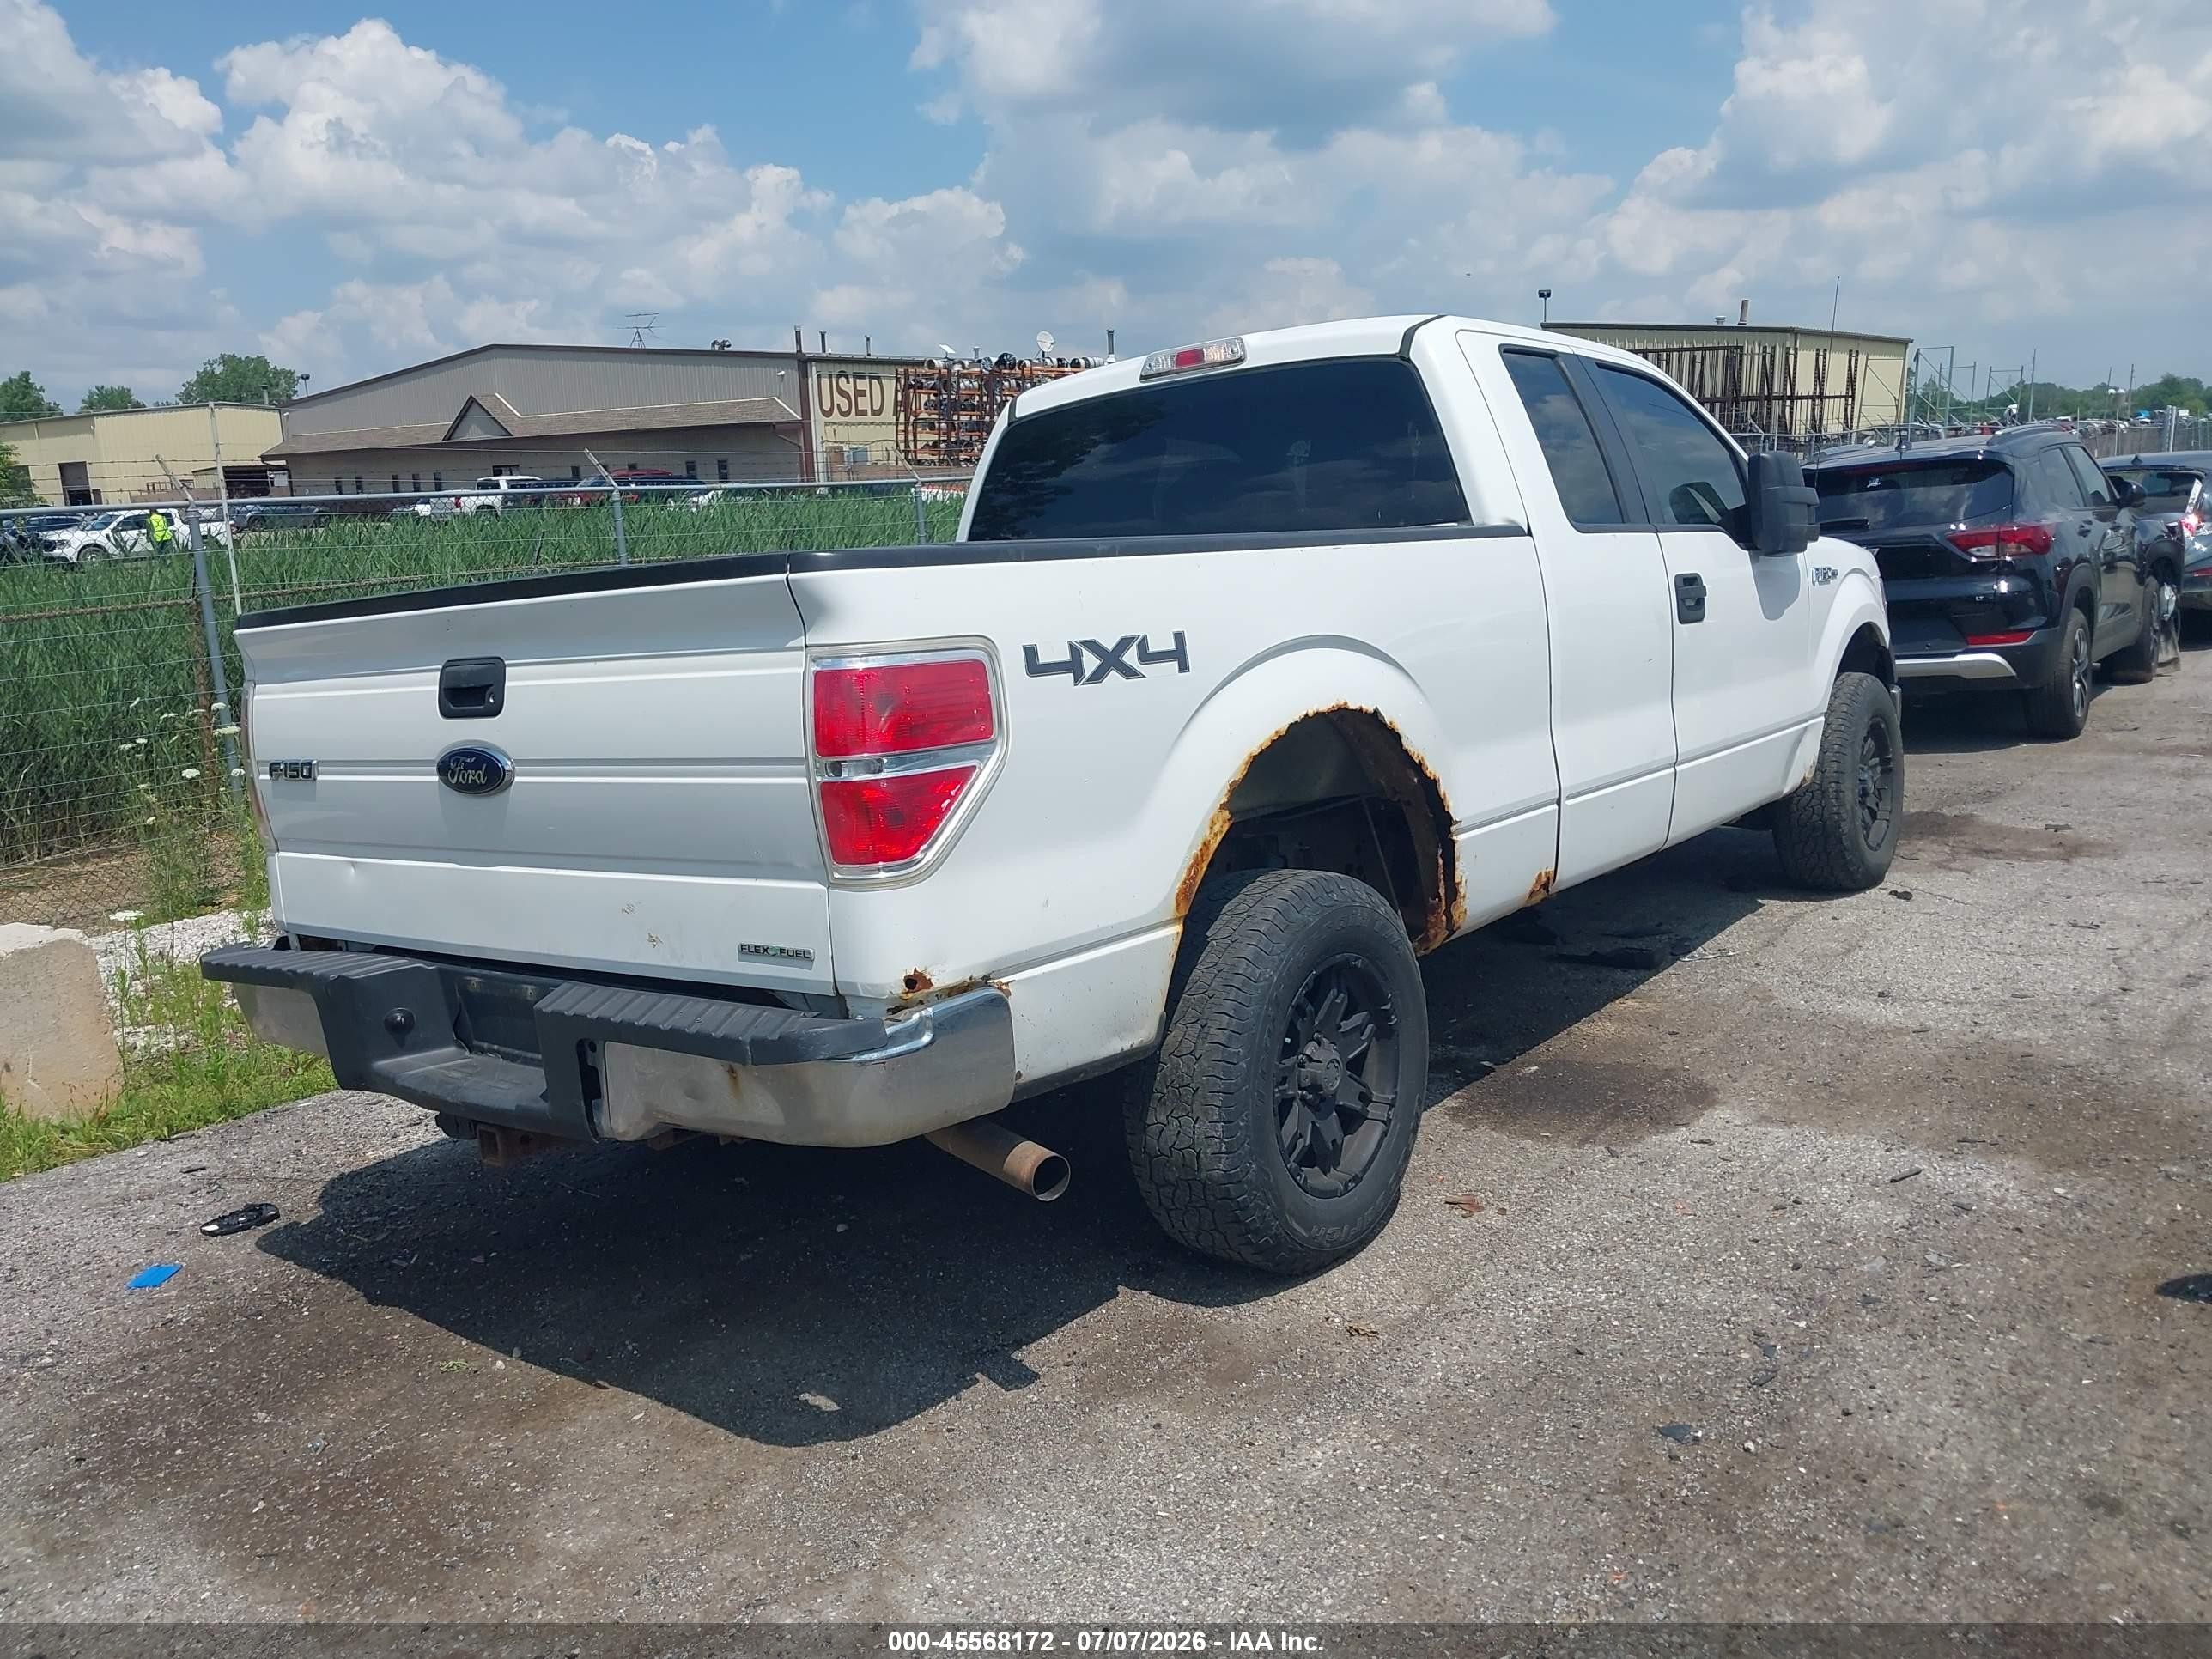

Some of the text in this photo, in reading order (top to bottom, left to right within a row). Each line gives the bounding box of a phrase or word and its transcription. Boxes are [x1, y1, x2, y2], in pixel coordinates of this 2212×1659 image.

[817, 370, 885, 418] USED
[447, 757, 488, 785] Ford
[740, 944, 811, 959] FLEX FUEL
